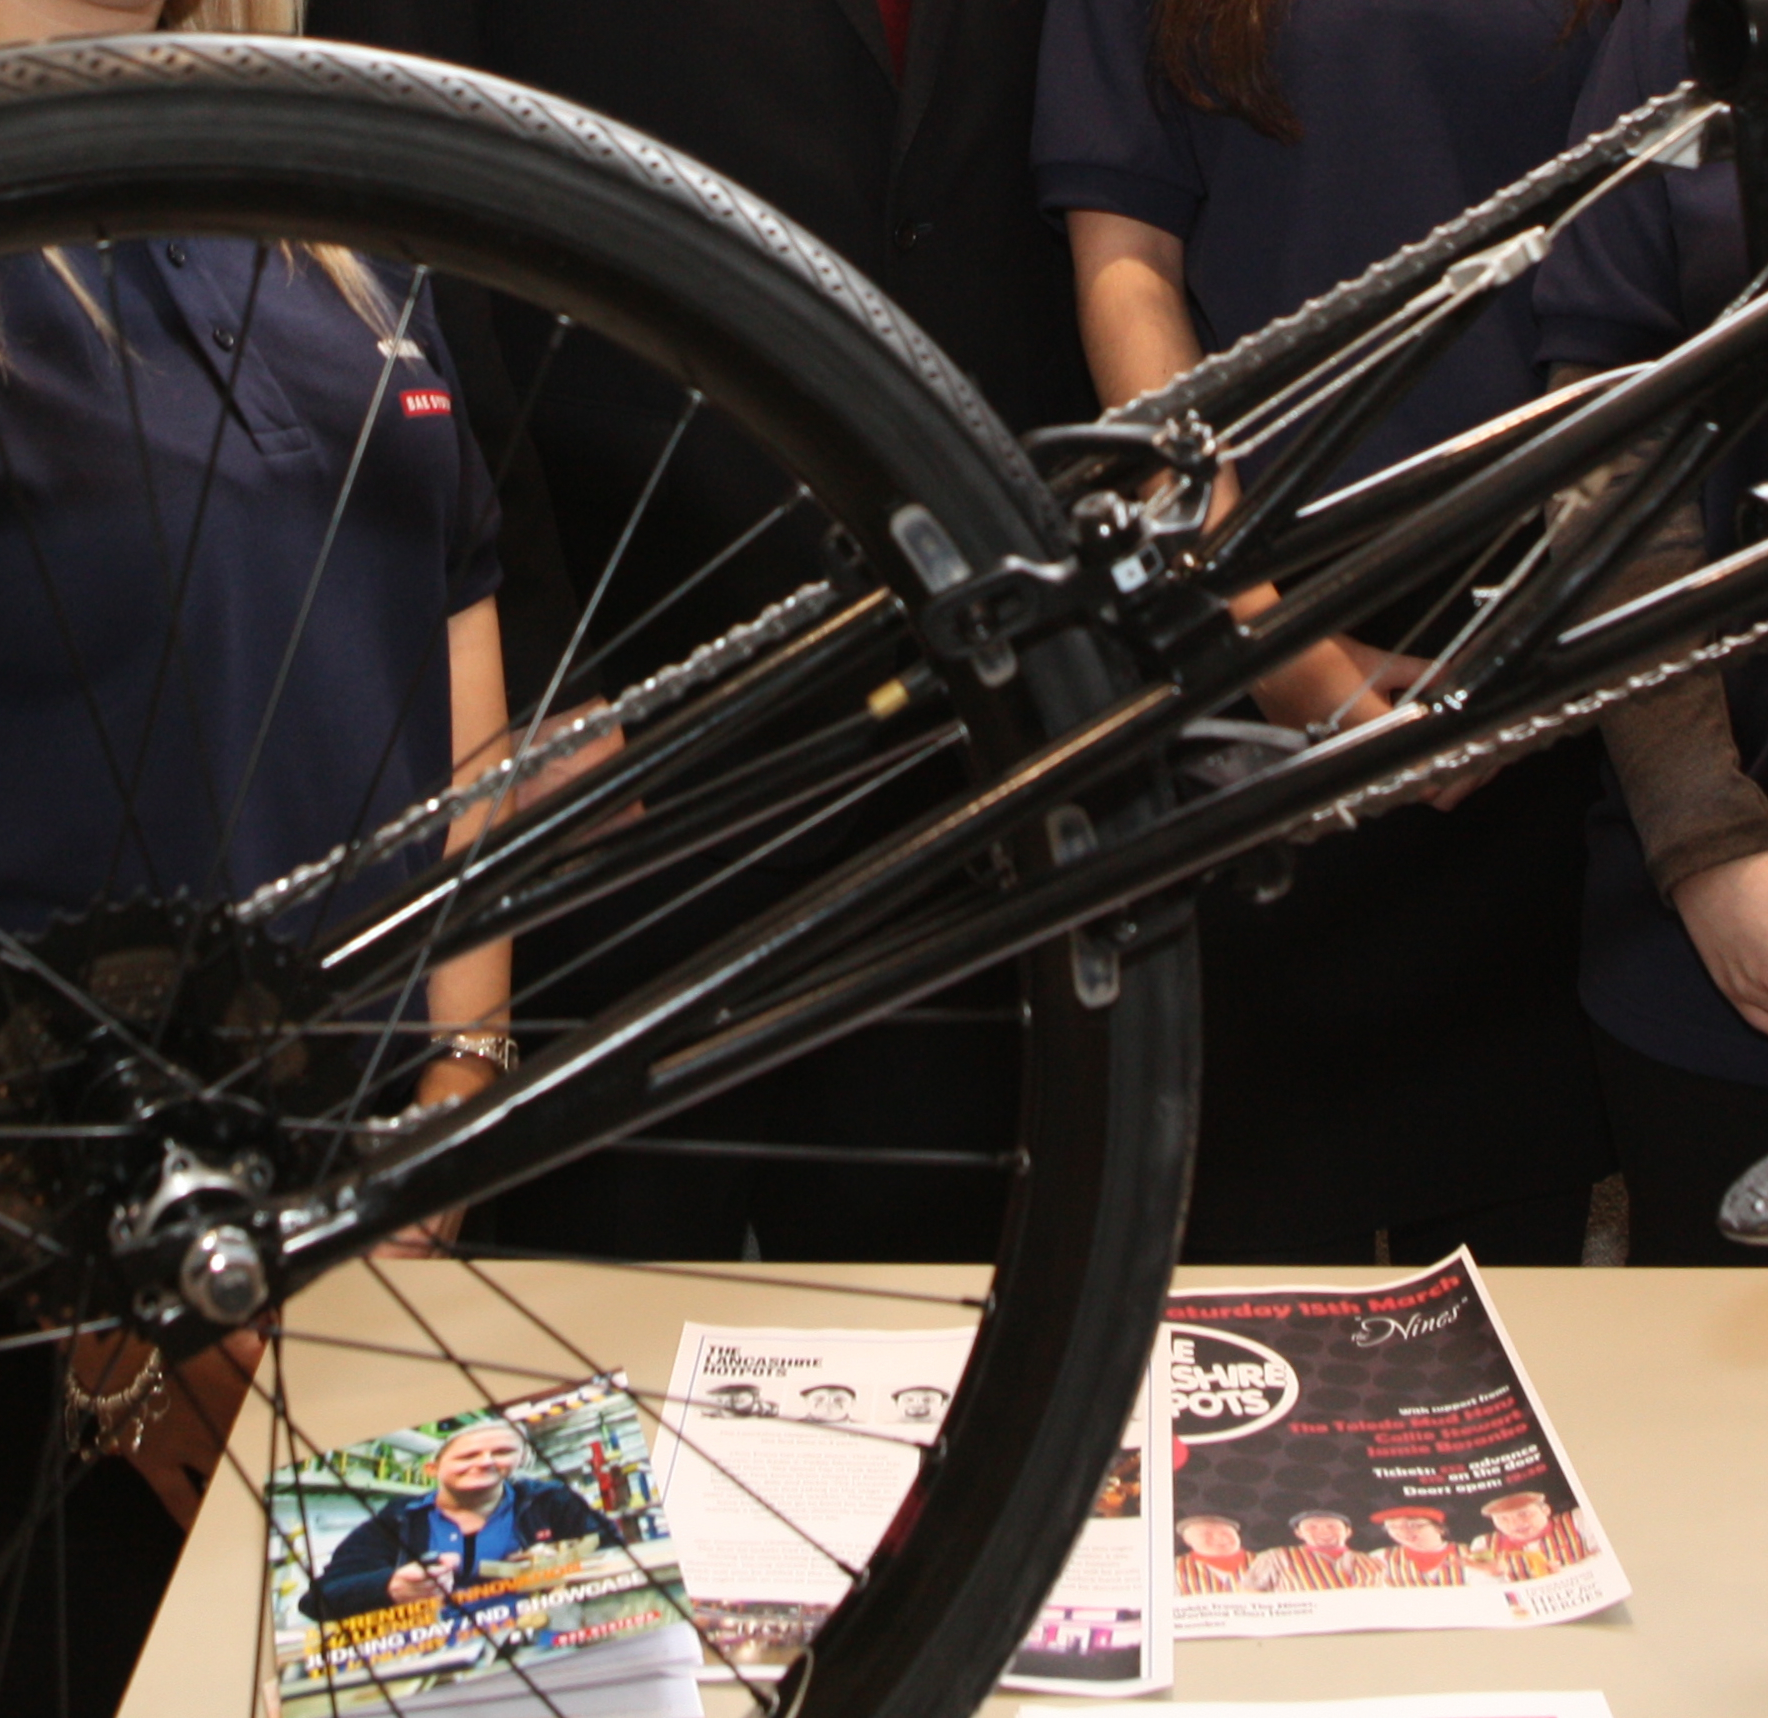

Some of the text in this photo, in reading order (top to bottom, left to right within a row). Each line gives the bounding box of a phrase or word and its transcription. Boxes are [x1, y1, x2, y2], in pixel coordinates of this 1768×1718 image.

[406, 394, 431, 412] BAE
[1166, 1275, 1461, 1321] aturday 15th March
[704, 1355, 823, 1369] LANCASHIRE
[709, 1344, 742, 1356] THE
[703, 1365, 788, 1378] HOTPOTS
[1171, 1362, 1288, 1392] SHIRE
[1171, 1388, 1271, 1418] POTS
[1398, 1405, 1430, 1417] With
[1432, 1397, 1477, 1414] support
[1288, 1421, 1329, 1433] The
[1333, 1419, 1406, 1432] Toledo
[1409, 1413, 1461, 1429] Mud
[1448, 1472, 1471, 1482] on
[1473, 1464, 1502, 1480] the
[1504, 1452, 1542, 1473] door
[1468, 1444, 1539, 1472] advance
[451, 1561, 583, 1605] NNOVATION
[410, 1619, 455, 1644] DAY
[515, 1566, 650, 1616] SHOWCASE
